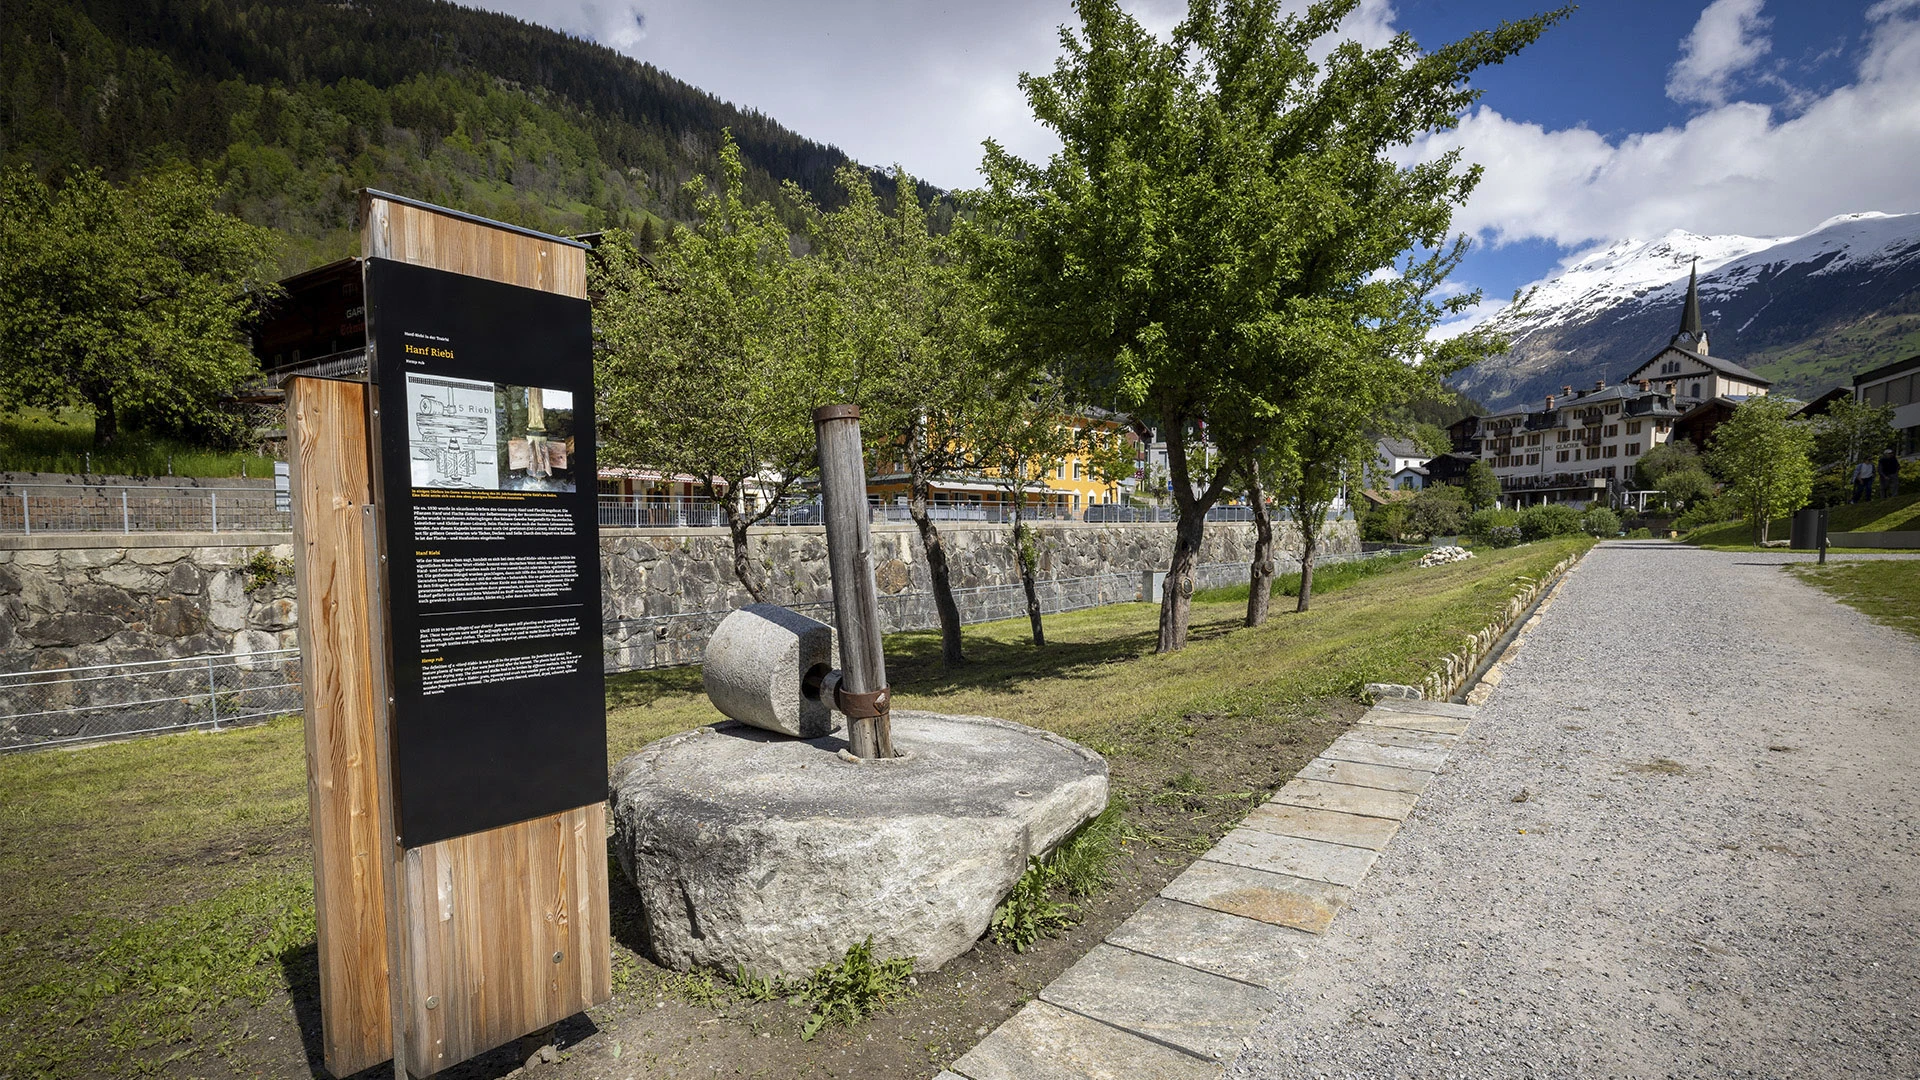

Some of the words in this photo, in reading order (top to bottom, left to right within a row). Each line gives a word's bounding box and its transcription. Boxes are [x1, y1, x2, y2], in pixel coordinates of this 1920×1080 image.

[405, 344, 429, 356] Hanf
[431, 348, 454, 359] Riebi
[469, 405, 492, 414] Riebi
